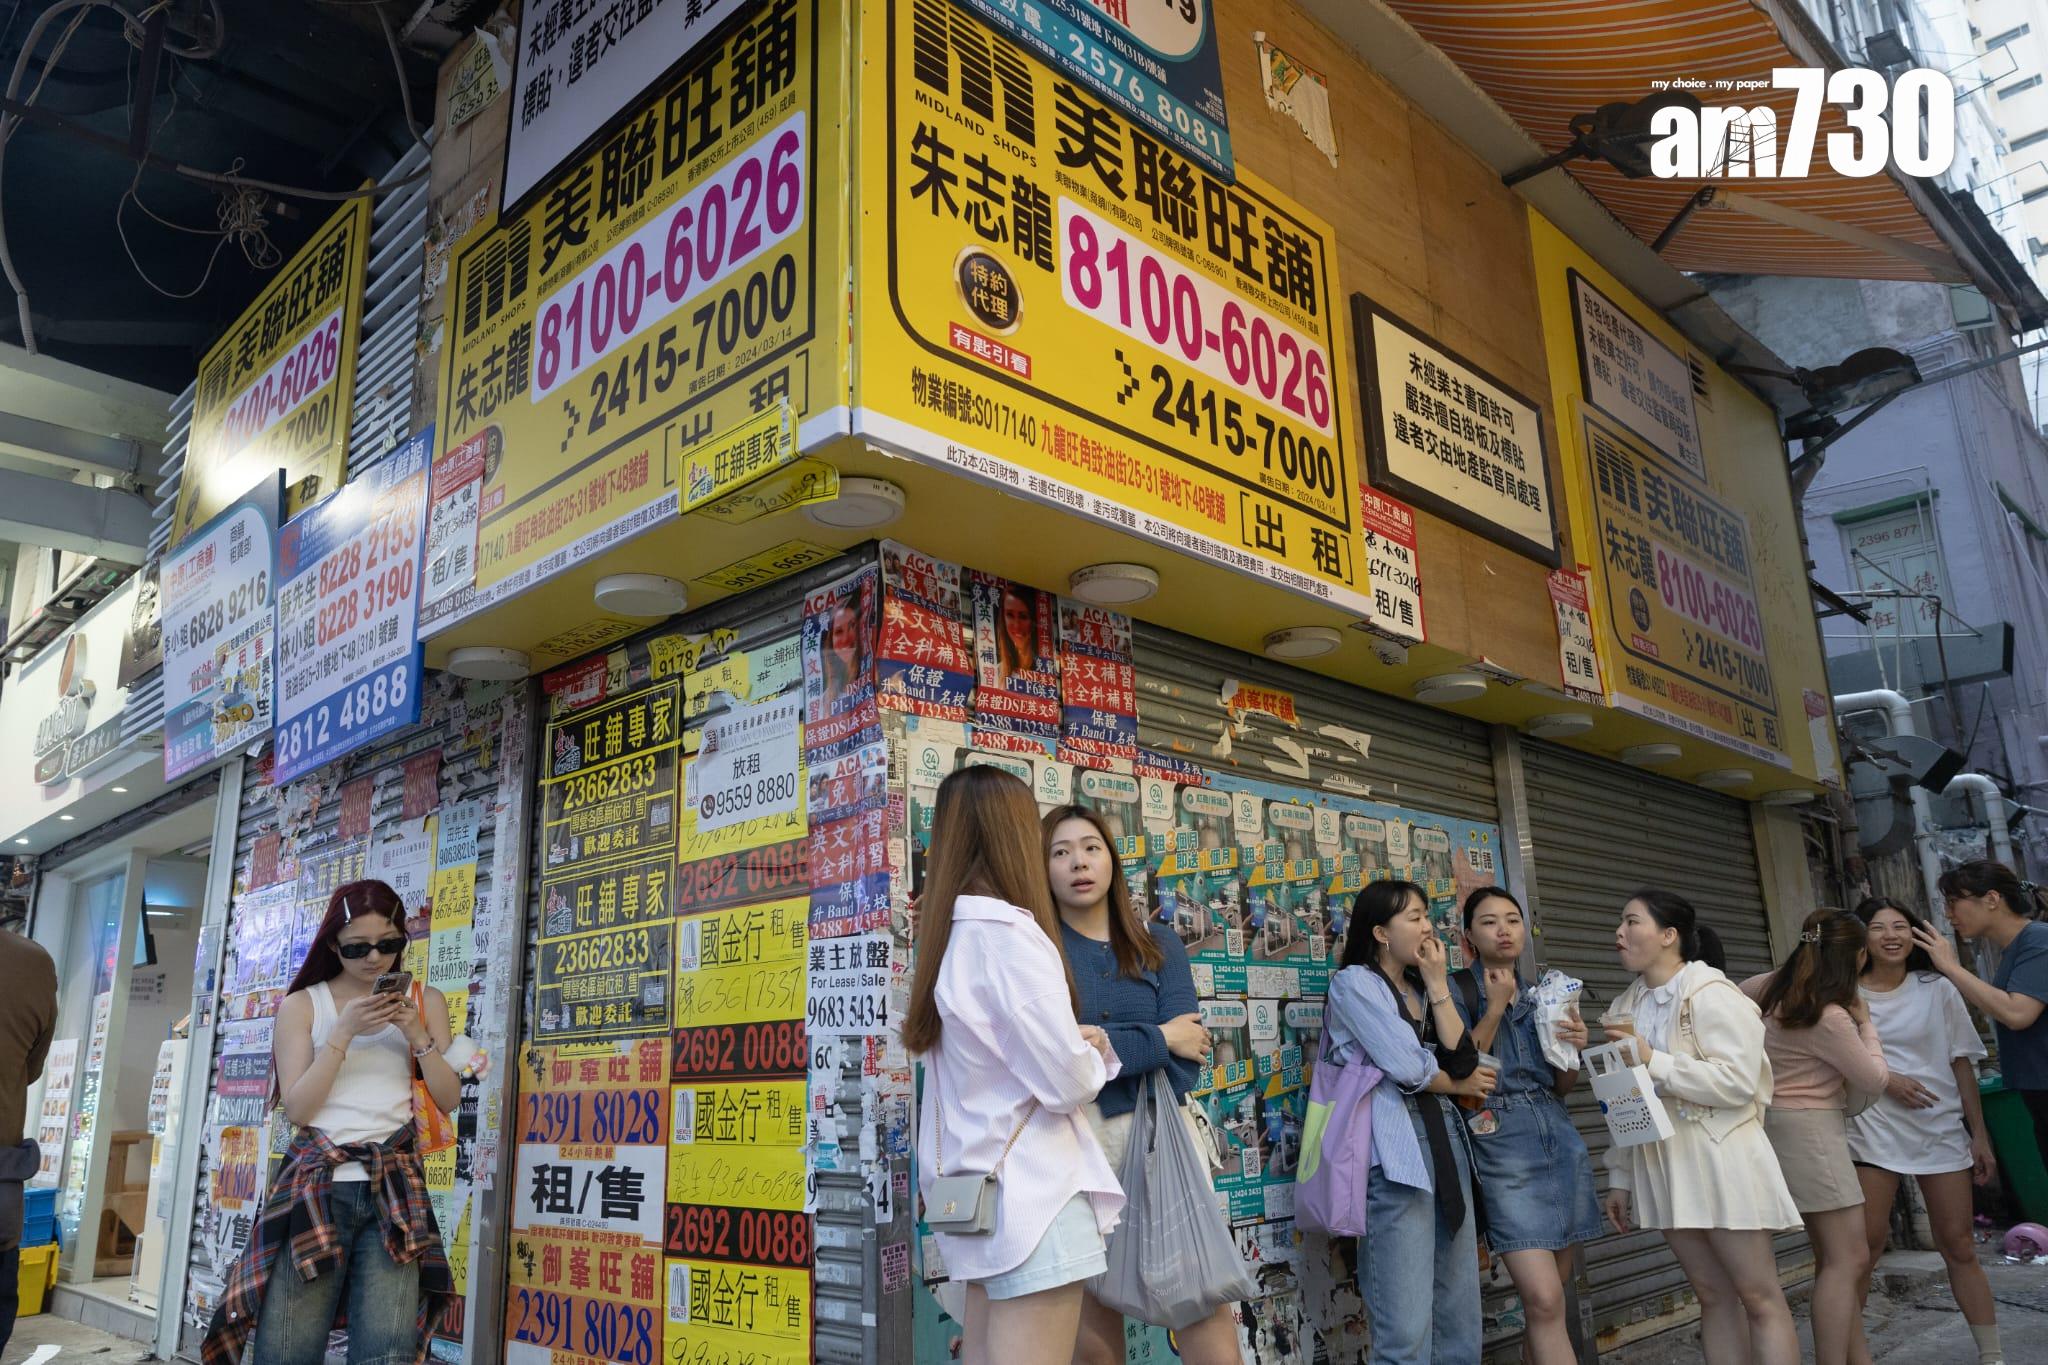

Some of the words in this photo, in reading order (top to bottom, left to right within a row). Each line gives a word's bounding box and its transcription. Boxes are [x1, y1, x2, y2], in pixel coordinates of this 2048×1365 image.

[1069, 34, 1144, 103] 2576
[1157, 94, 1222, 156] 8081
[540, 3, 797, 276] 美聯旺舖
[915, 89, 985, 137] MIDLAND
[992, 134, 1038, 168] SHOPS
[910, 122, 1055, 273] 朱志龍
[1054, 80, 1318, 316] 美聯旺舖
[537, 129, 800, 392] 8100-6026
[970, 260, 1008, 297] 特約
[232, 227, 347, 388] 美聯旺舖
[461, 323, 497, 356] MIDLAND
[500, 302, 527, 325] SHOPS
[970, 287, 1009, 322] 代理
[1068, 214, 1331, 429] 8100-6026
[587, 253, 796, 437] 2415-7000
[735, 325, 793, 369] 2024/03/14
[952, 327, 1029, 374] 有匙引看
[454, 320, 533, 435] 朱志龍
[1408, 351, 1516, 435] 未經業主書面許可
[1151, 363, 1335, 499] 2415-7000
[1404, 382, 1525, 472] 嚴禁擅自掛板及標貼
[714, 426, 779, 488] 旺舖專家
[1393, 411, 1542, 513] 違者交由地產監管局處理
[1641, 468, 1748, 577] 美聯旺舖
[1858, 531, 1890, 548] 2396
[319, 541, 362, 599] 8228
[905, 553, 936, 577] ACA
[1605, 518, 1658, 590] 朱志龍
[189, 599, 224, 649] 6828
[228, 570, 267, 624] 9216
[317, 589, 359, 647] 8228
[363, 558, 414, 621] 3190
[455, 585, 476, 607] 0188
[803, 590, 837, 617] ACA
[904, 569, 938, 603] 免費
[1375, 588, 1414, 628] 租/售
[1657, 550, 1762, 652] 8100-6026
[887, 600, 960, 647] 英文補習
[1083, 607, 1111, 625] ACA
[659, 651, 694, 675] 9178
[893, 632, 969, 671] 全科補習
[978, 603, 996, 687] 英文補習
[1566, 651, 1594, 679] 租/售
[1695, 632, 1769, 697] 2415-7000
[806, 637, 822, 722] 英文補習
[898, 681, 927, 701] Band
[939, 690, 966, 708] 名校
[908, 663, 944, 688] 保證
[1064, 655, 1132, 689] 英文補習
[1074, 683, 1134, 712] 全科補習
[278, 705, 330, 767] 2812
[339, 665, 408, 731] 4888
[585, 698, 673, 763] 旺舖專家
[882, 693, 915, 715] 2388
[917, 699, 951, 721] 7323
[980, 711, 1013, 734] 2388
[1014, 717, 1045, 736] 7323
[1091, 709, 1118, 730] 保證
[810, 740, 841, 764] 2388
[1069, 735, 1097, 753] 2388
[1098, 741, 1125, 758] 7323
[1081, 724, 1106, 740] Band
[1115, 731, 1137, 748] 名校
[1149, 754, 1174, 770] Band
[563, 755, 656, 810] 23662833
[733, 752, 761, 781] 放租
[835, 754, 864, 777] ACA
[915, 768, 945, 779] STORAGE
[1039, 786, 1065, 797] STORAGE
[716, 783, 752, 816] 9559
[757, 772, 796, 810] 8880
[577, 869, 666, 929] 旺舖專家
[680, 855, 738, 905] 2692
[827, 901, 854, 919] Band
[555, 929, 649, 974] 23662833
[700, 909, 761, 968] 國金行
[809, 941, 889, 972] 業主放盤
[811, 976, 827, 989] For
[807, 996, 846, 1029] 9683
[848, 995, 888, 1027] 5434
[676, 1029, 735, 1072] 2692
[743, 1020, 809, 1069] 0088
[528, 1090, 582, 1144] 2391
[592, 1089, 660, 1144] 8028
[693, 1087, 762, 1143] 國金行
[530, 1163, 645, 1221] 租/售
[668, 1206, 731, 1260] 2692
[738, 1210, 808, 1263] 0088
[543, 1243, 654, 1300] 御峯旺舖
[689, 1268, 759, 1331] 國金行
[515, 1288, 575, 1350] 2391
[584, 1299, 653, 1365] 8028
